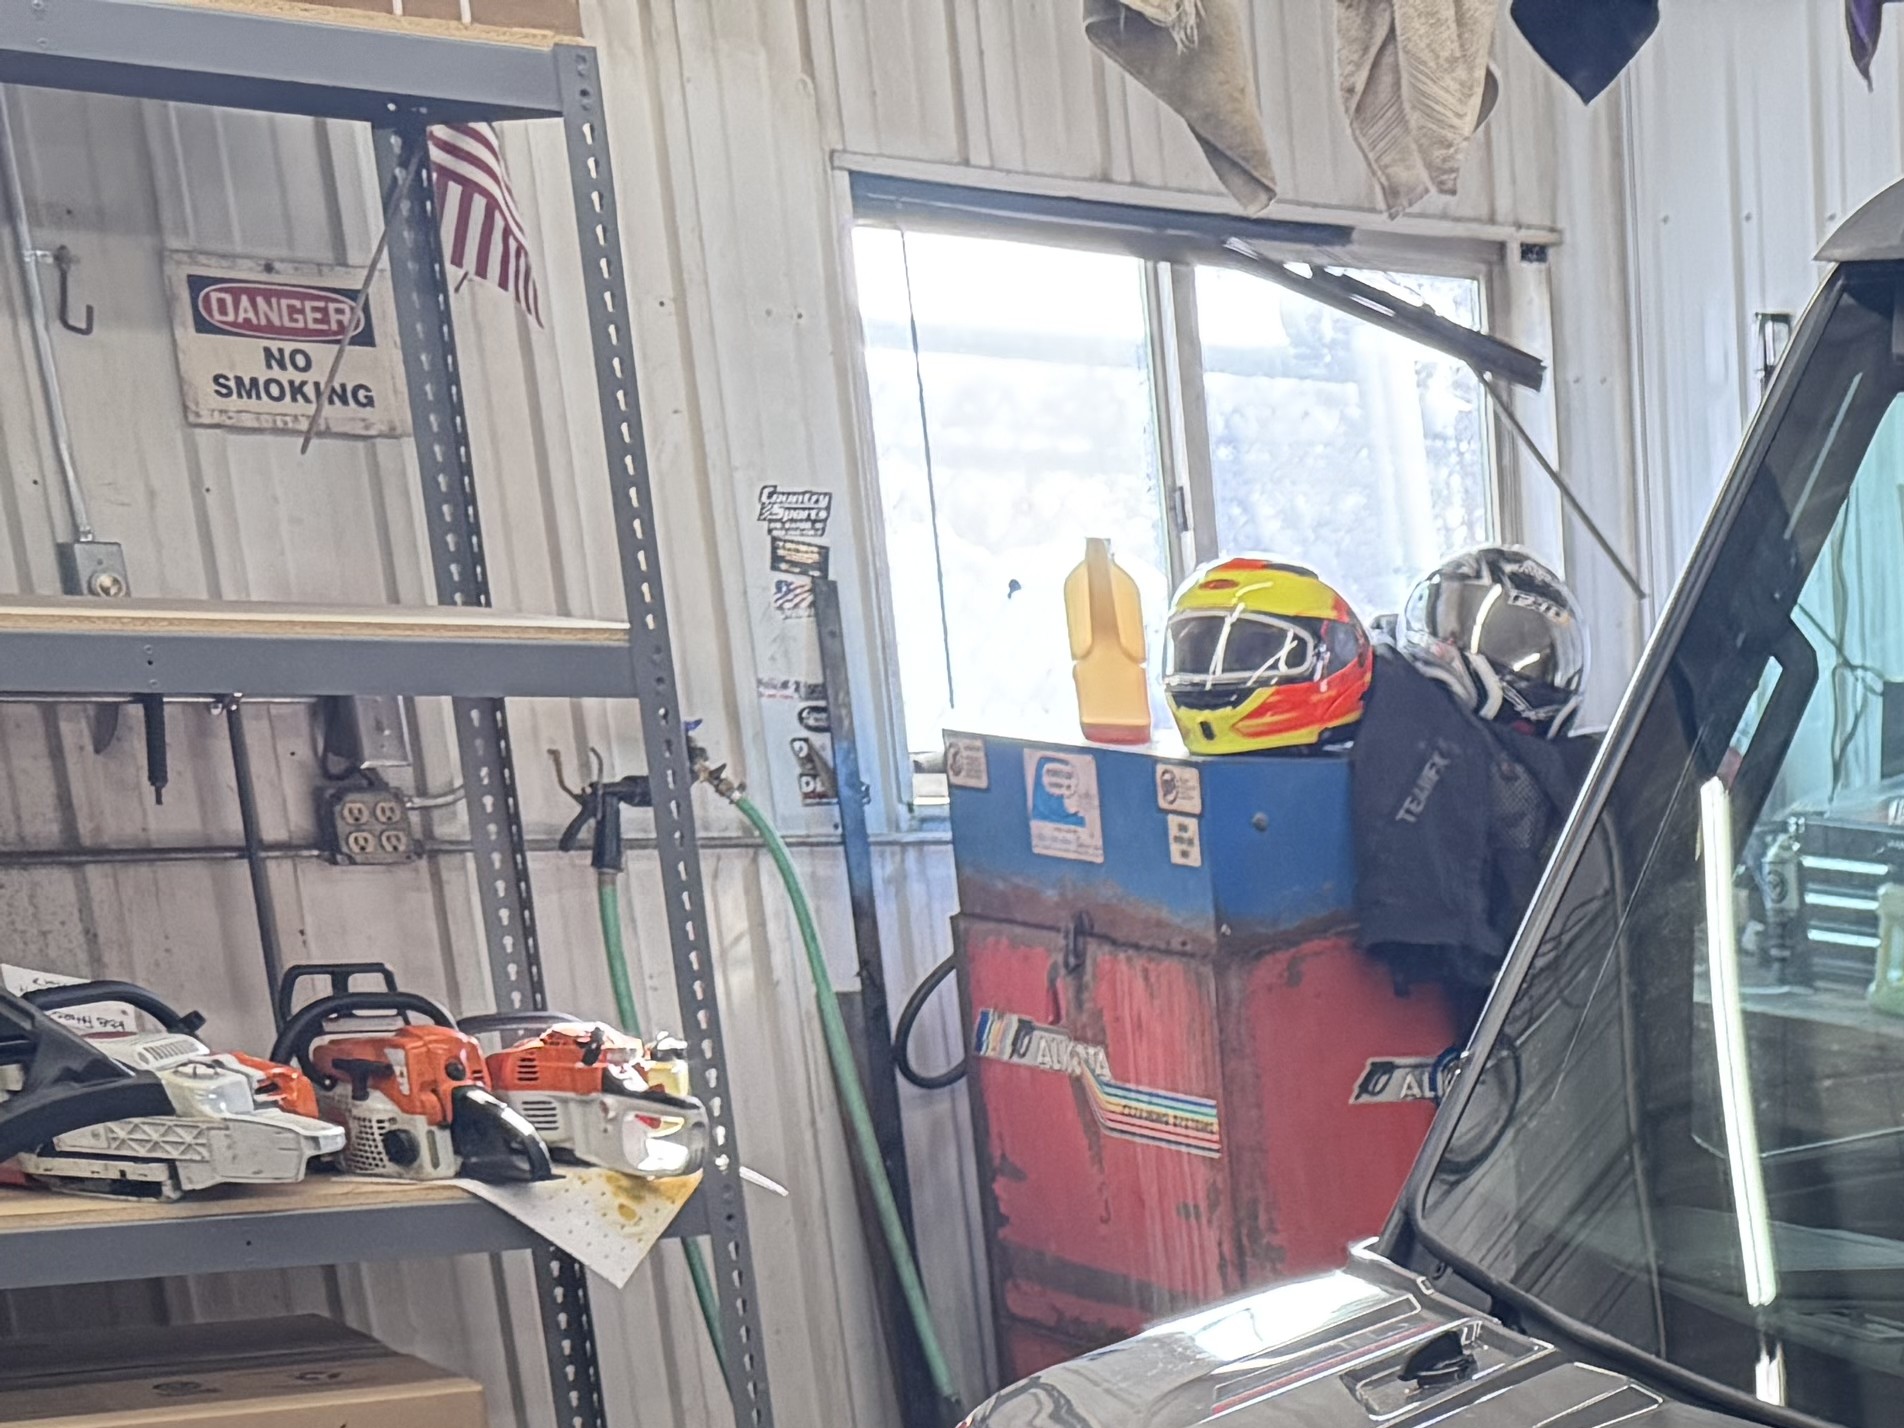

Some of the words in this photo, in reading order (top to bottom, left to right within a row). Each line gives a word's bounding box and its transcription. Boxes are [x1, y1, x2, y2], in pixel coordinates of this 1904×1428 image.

[209, 292, 352, 331] DANGER
[262, 346, 313, 373] NO
[212, 373, 376, 409] SMOKING
